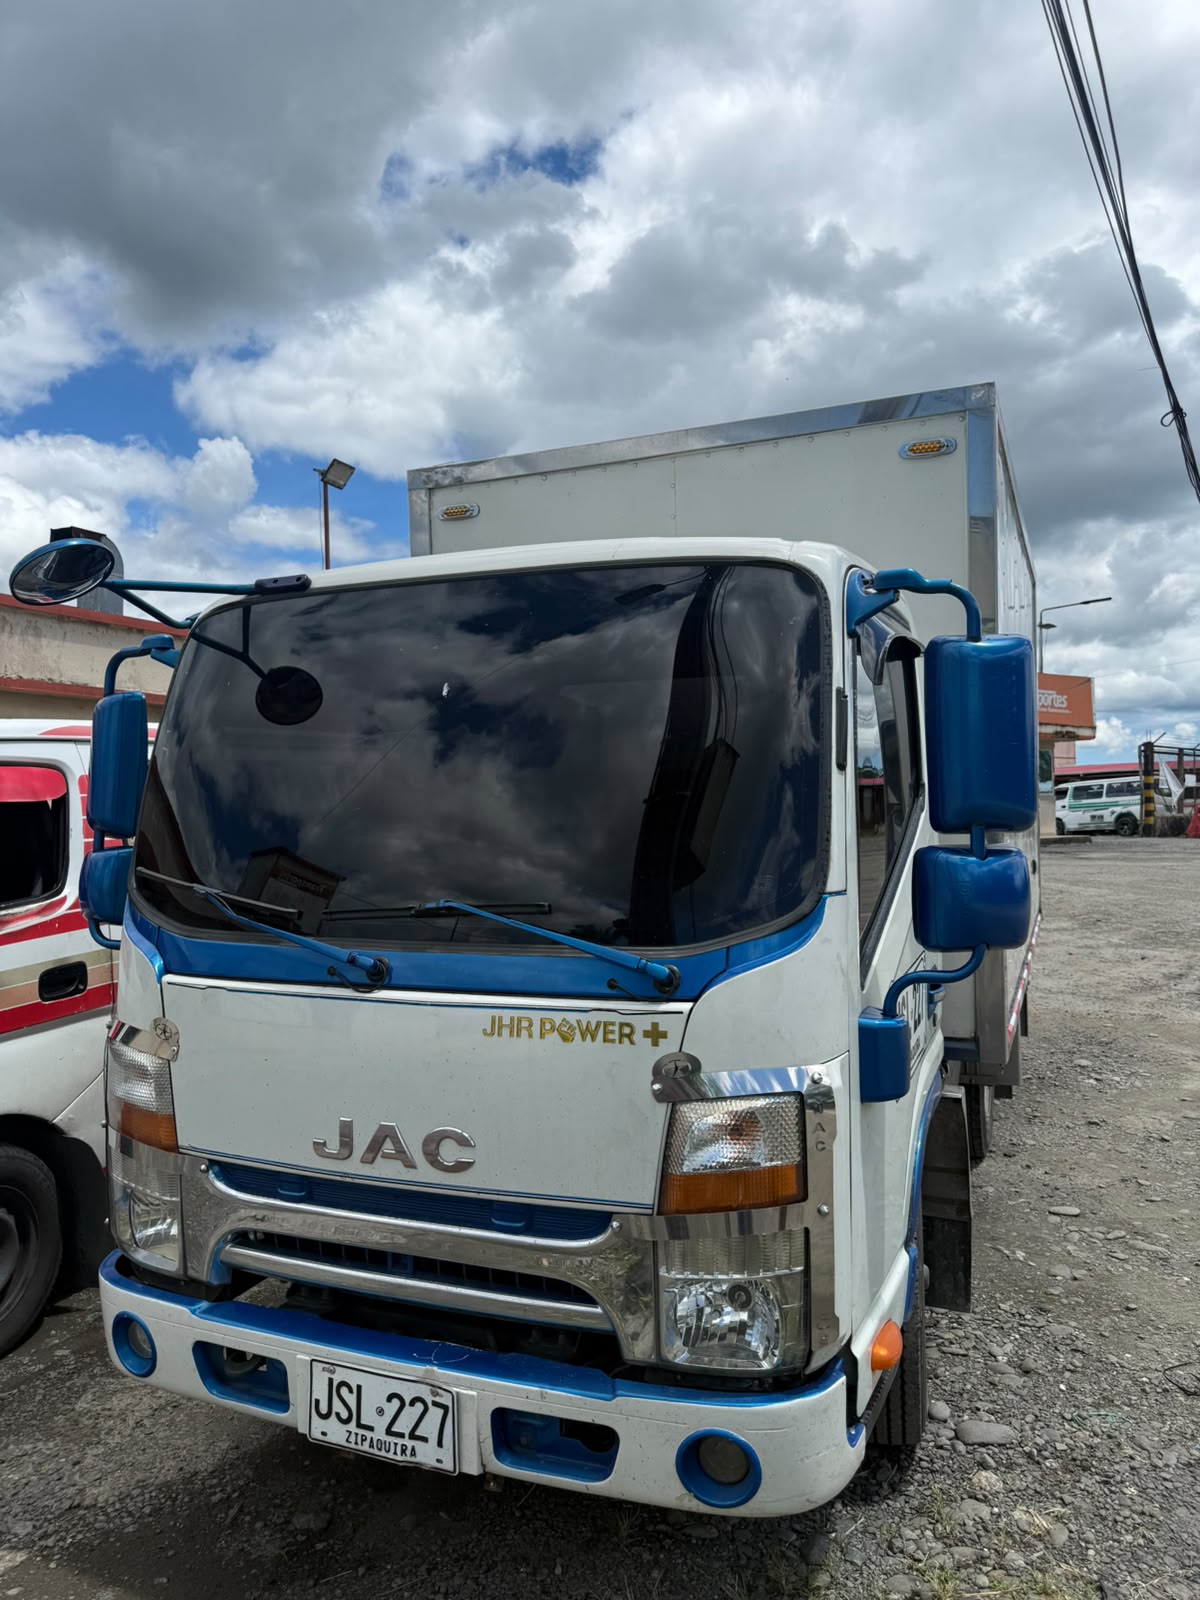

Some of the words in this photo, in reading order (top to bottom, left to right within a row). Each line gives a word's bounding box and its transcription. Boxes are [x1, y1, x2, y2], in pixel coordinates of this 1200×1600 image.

[482, 1015, 534, 1039] JHR
[312, 1116, 477, 1174] JAC
[314, 1377, 375, 1432] JSL
[385, 1392, 450, 1449] 227
[345, 1429, 418, 1459] ZIPAQUIRA
